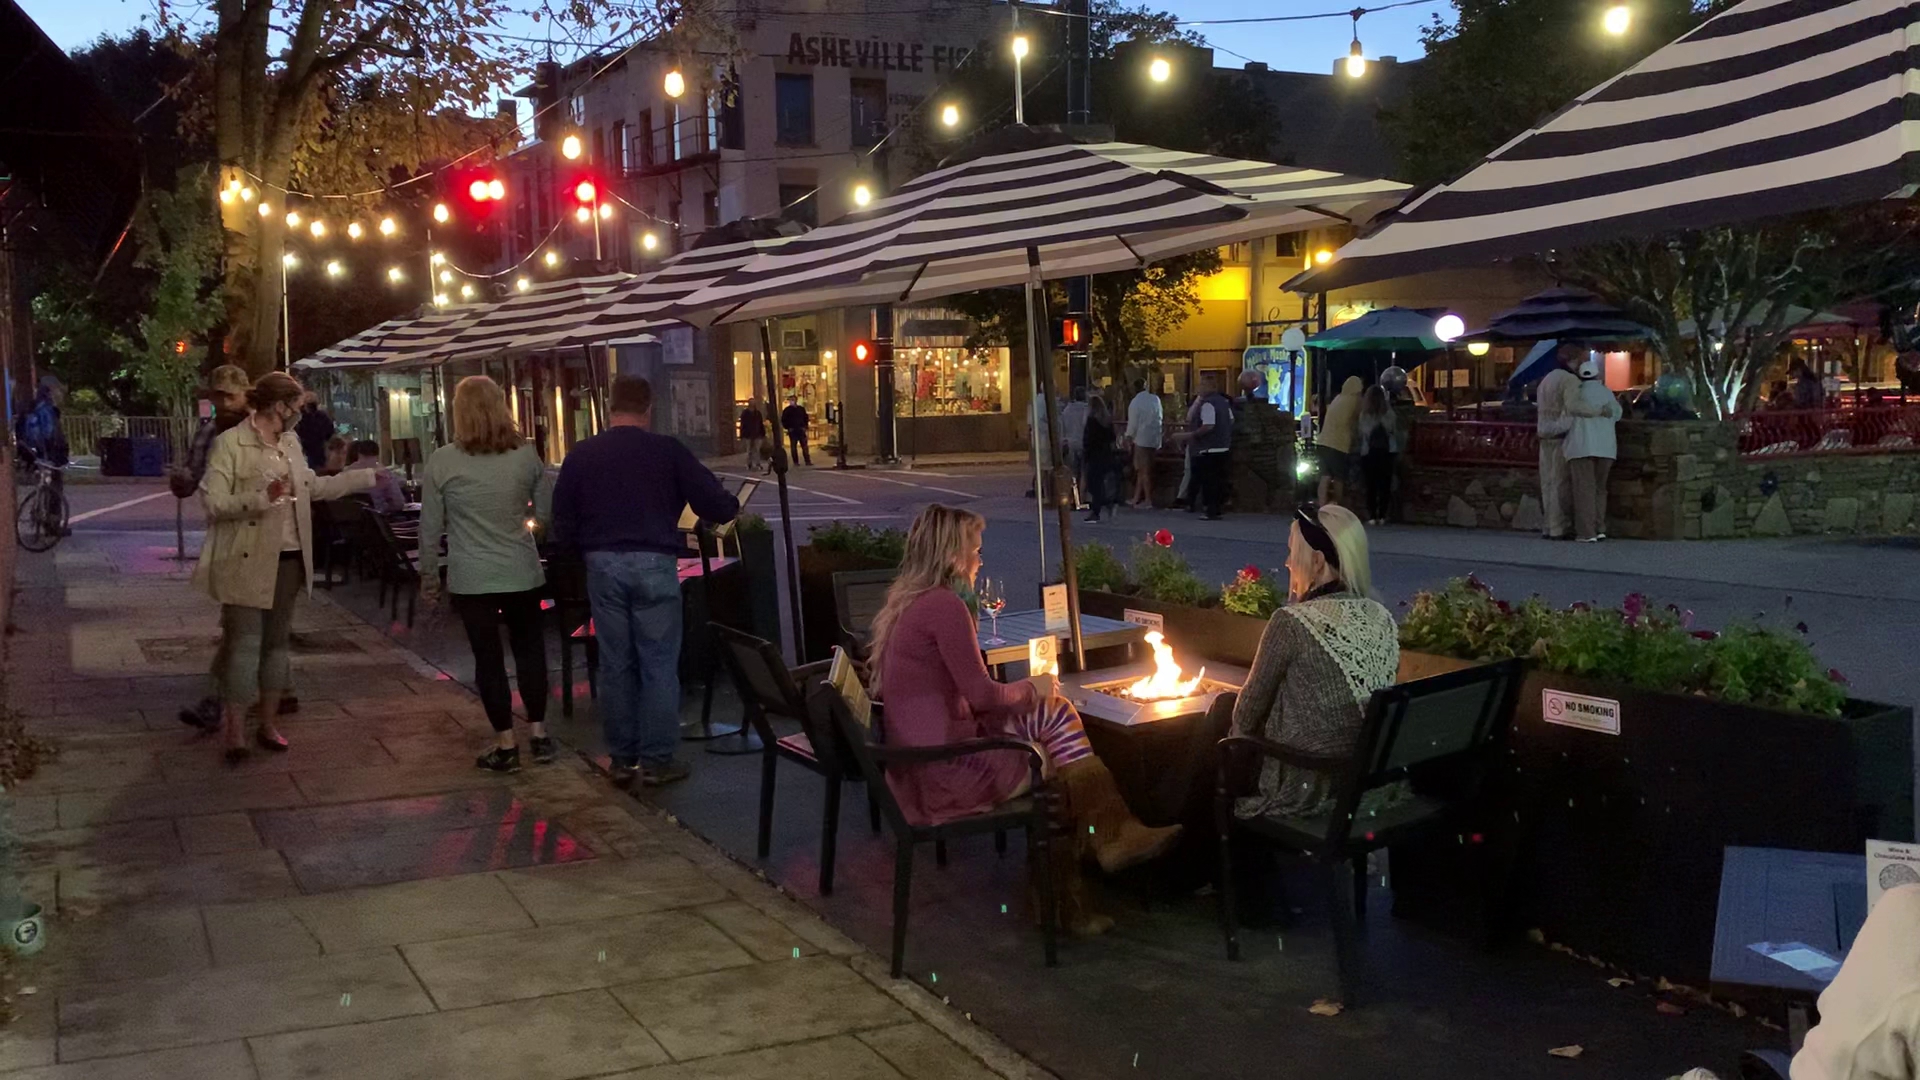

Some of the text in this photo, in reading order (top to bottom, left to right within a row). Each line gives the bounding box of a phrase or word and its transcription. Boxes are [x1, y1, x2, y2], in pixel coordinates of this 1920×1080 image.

[788, 33, 923, 72] ASHEVILLE
[1565, 701, 1614, 718] NO SMOKING
